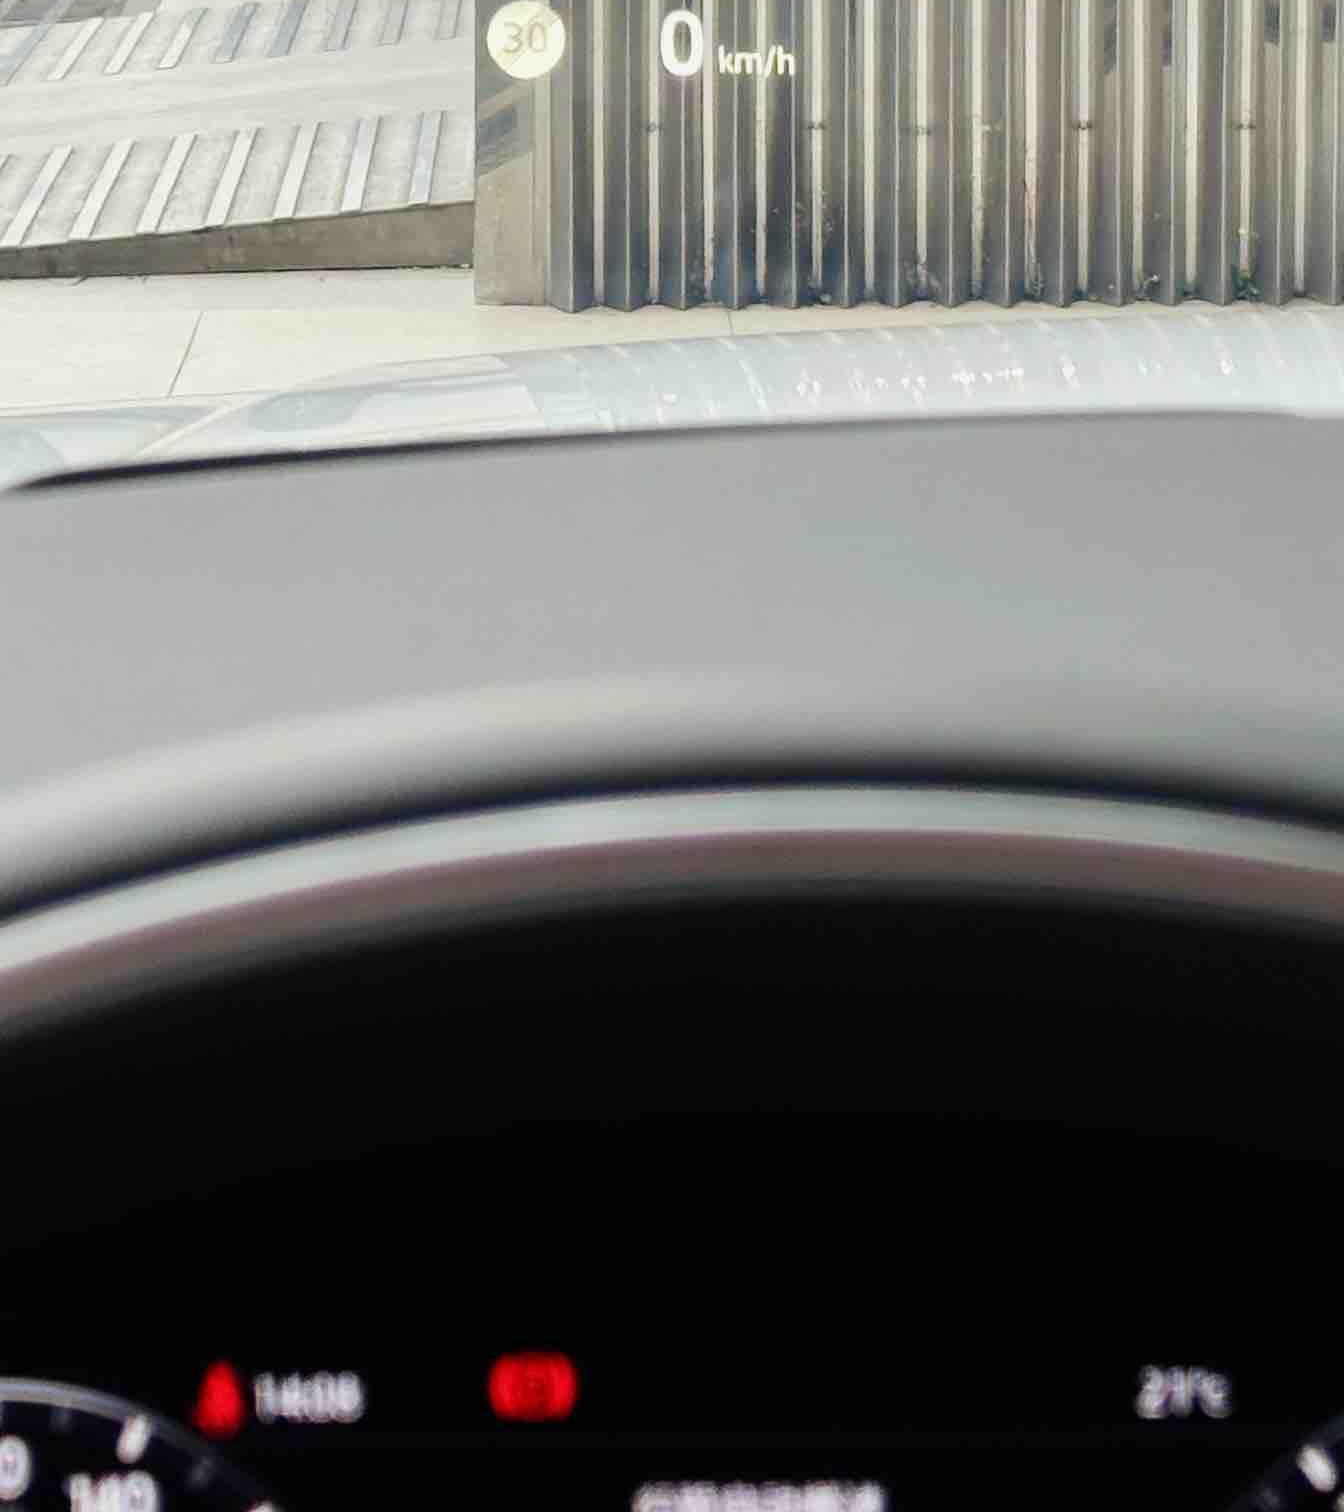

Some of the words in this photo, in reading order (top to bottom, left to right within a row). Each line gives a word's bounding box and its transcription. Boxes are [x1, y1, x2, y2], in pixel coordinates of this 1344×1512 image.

[502, 22, 548, 54] 30
[660, 9, 704, 78] 0
[718, 43, 796, 77] km/h
